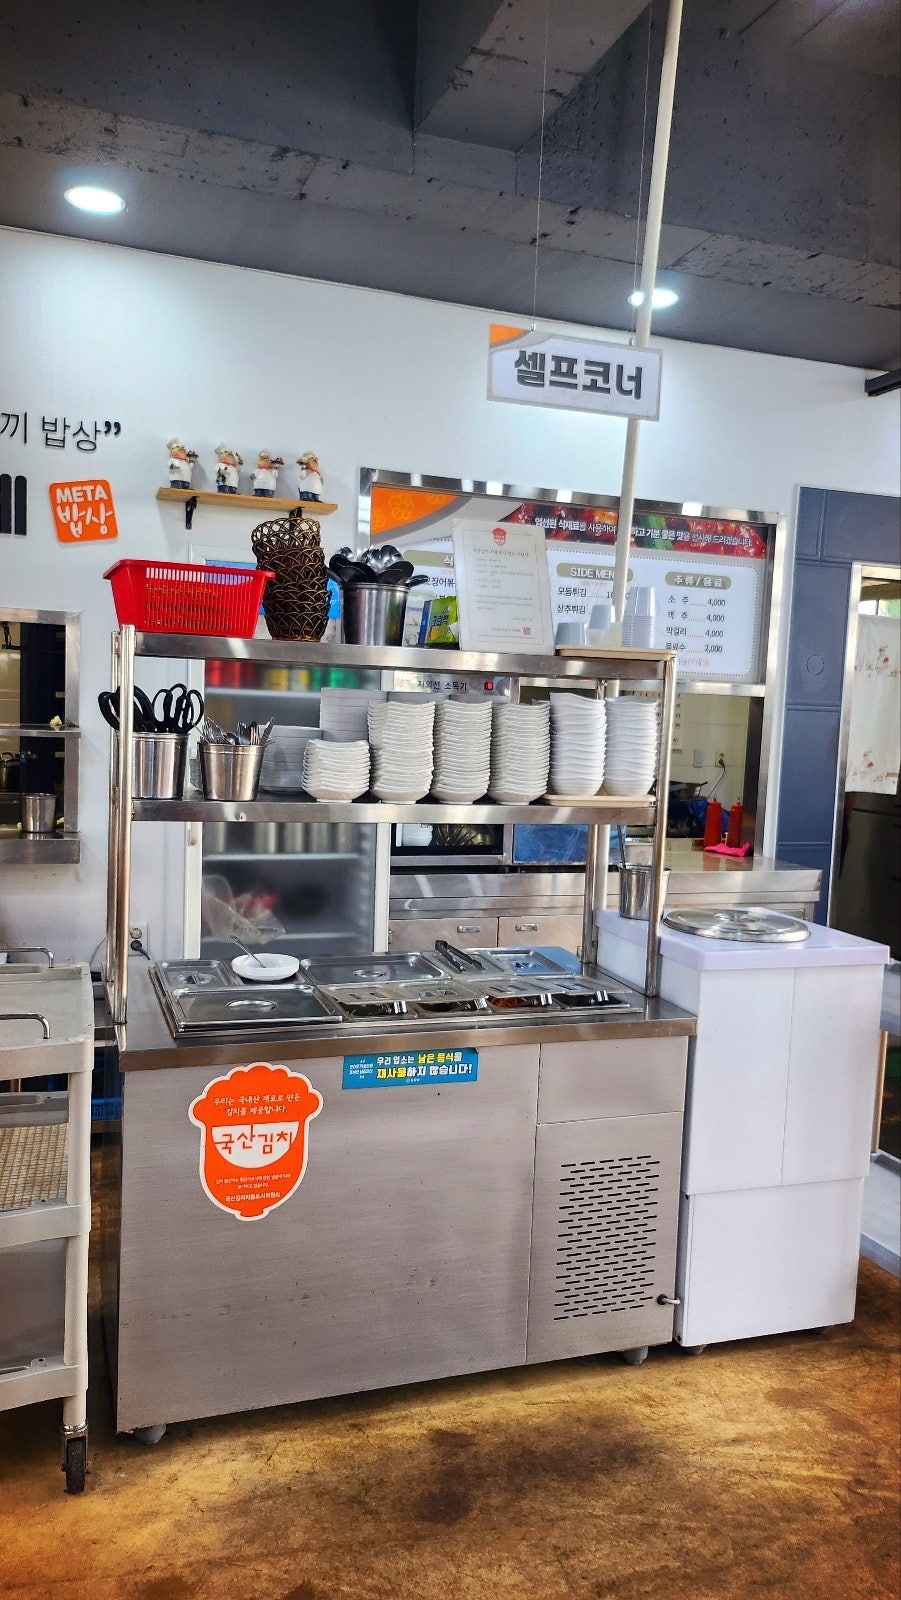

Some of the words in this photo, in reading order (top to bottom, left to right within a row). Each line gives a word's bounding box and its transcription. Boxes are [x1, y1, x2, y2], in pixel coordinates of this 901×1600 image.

[514, 350, 643, 400] 셀프코너
[56, 485, 108, 503] META
[56, 503, 113, 538] 밥상
[534, 517, 557, 529] 엄선된
[588, 523, 616, 535] 사용하여
[647, 528, 661, 538] 기분
[570, 567, 594, 578] SIDE
[595, 569, 616, 580] MEN
[558, 586, 587, 598] 모듬튀김
[707, 598, 726, 607] 4,000
[556, 604, 586, 615] 상추튀김
[706, 613, 725, 623] 4,000
[666, 626, 687, 637] 막걸리
[705, 629, 724, 639] 4,000
[704, 644, 723, 653] 2,000
[417, 681, 441, 692] 자외선
[444, 682, 468, 692] 소독기
[377, 1057, 391, 1066] 우리
[393, 1055, 415, 1065] 업소는
[418, 1053, 436, 1064] 남은
[437, 1051, 463, 1063] 음식을
[376, 1066, 427, 1079] 재사용하지
[213, 1096, 235, 1106] 우리는
[238, 1095, 260, 1105] 국내산
[263, 1094, 284, 1103] 재료로
[286, 1092, 302, 1102] 만든
[226, 1107, 247, 1117] 김치를
[250, 1105, 288, 1115] 제공합니다.
[214, 1125, 293, 1155] 국산김치
